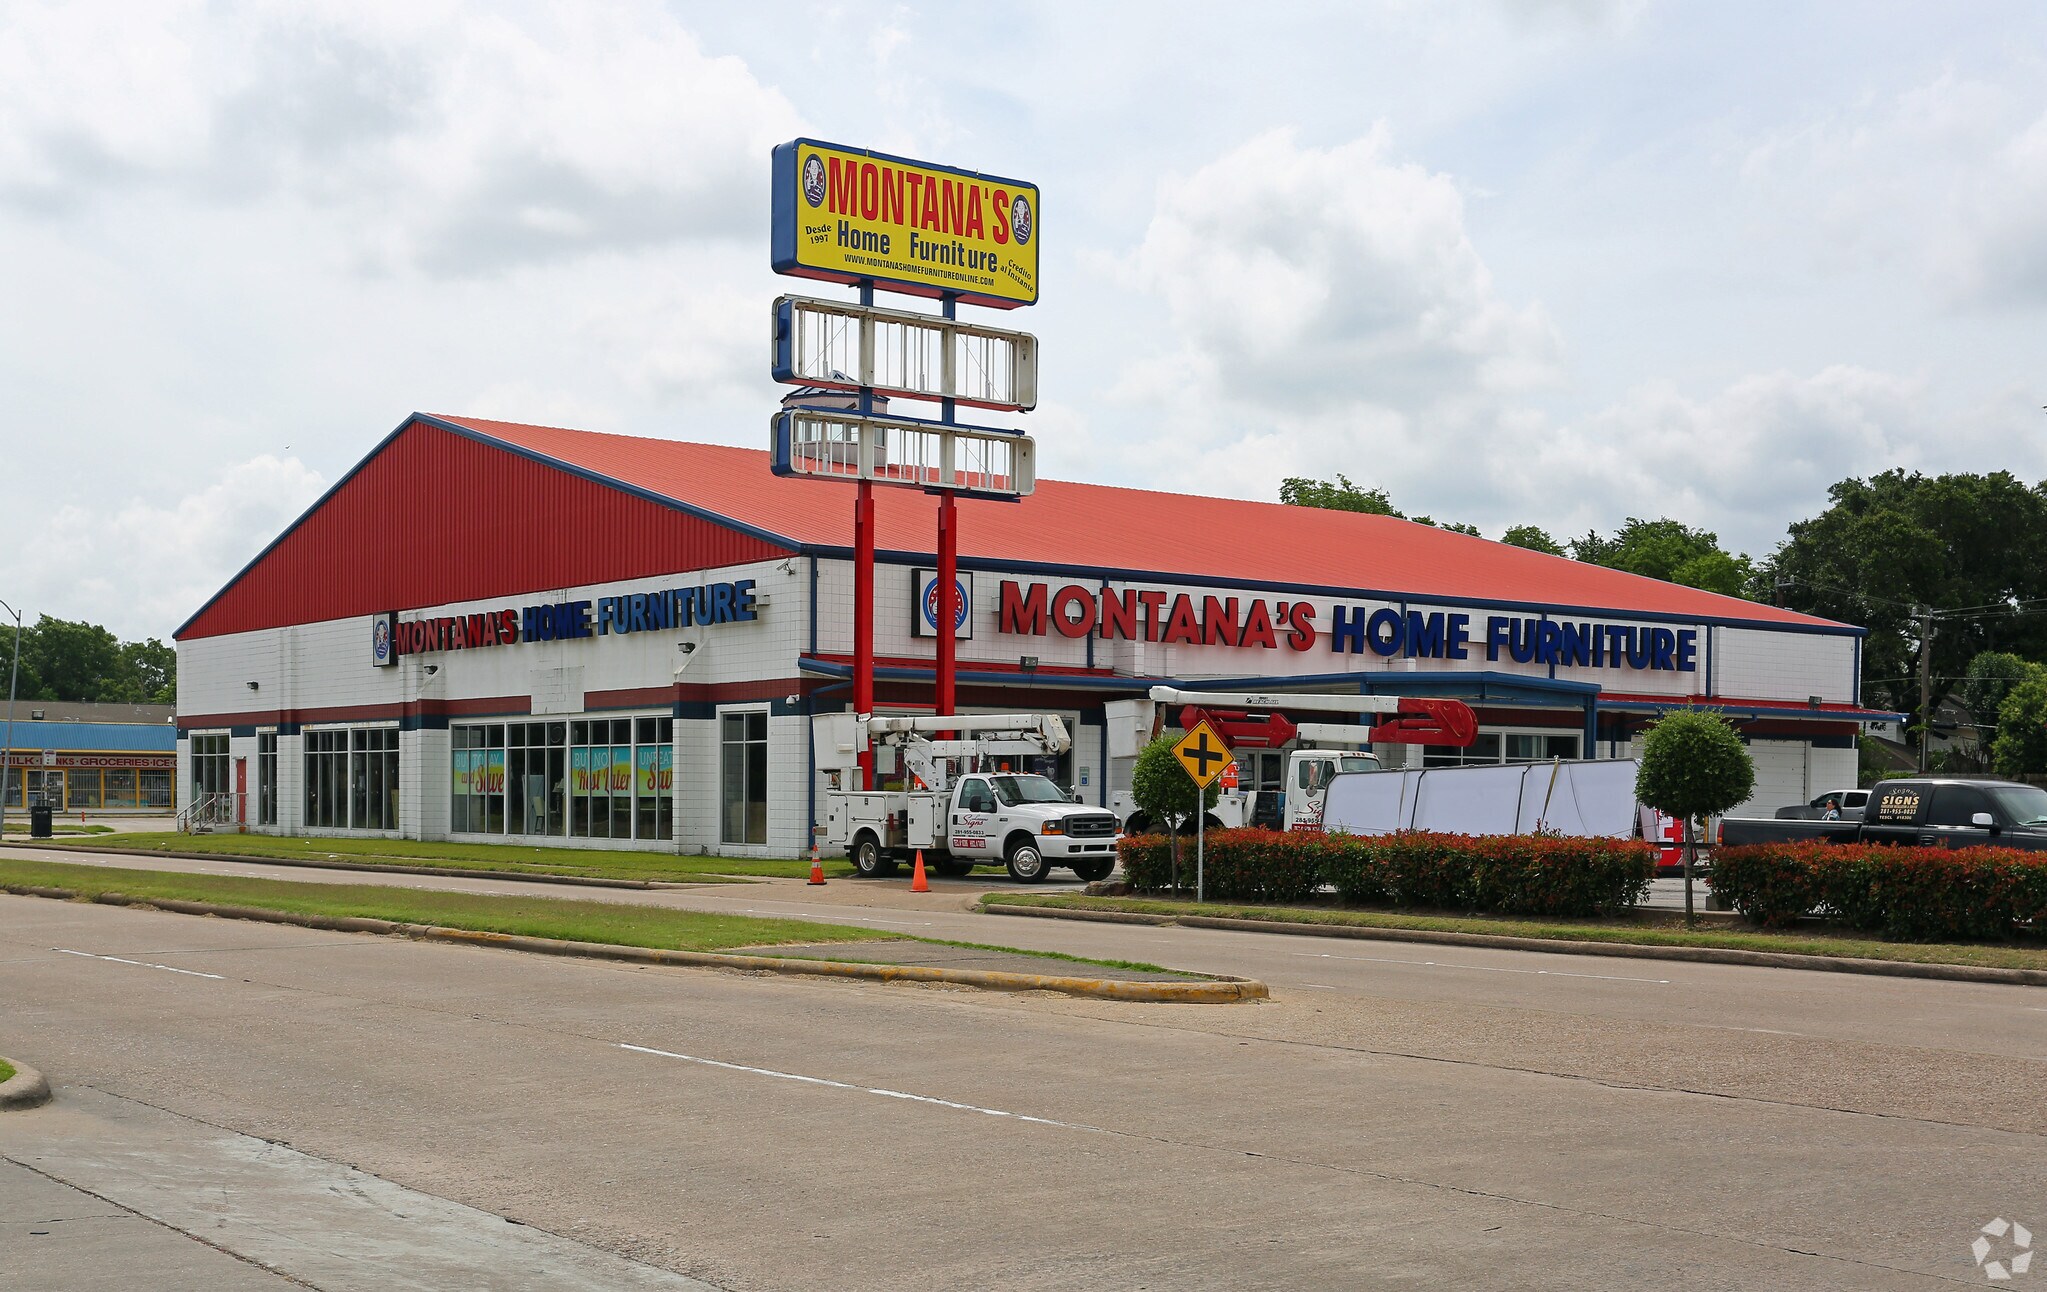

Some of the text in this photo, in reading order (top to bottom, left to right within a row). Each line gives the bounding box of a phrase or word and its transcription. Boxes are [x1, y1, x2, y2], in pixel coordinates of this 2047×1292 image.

[828, 156, 1009, 245] MONTANA'S
[805, 223, 832, 235] Desde
[810, 234, 829, 245] 1997
[837, 219, 998, 273] Home Furniture
[844, 253, 995, 286] WWW.MONTANASHOMEFURNITUREONLINE.COM
[1007, 268, 1034, 293] Instante
[1008, 259, 1032, 280] Credito
[395, 578, 757, 656] MONTANA'S HOME FURNITURE
[1000, 579, 1697, 673] MONTANA'S HOME FURNITURE
[80, 757, 150, 767] GROCERIES
[152, 758, 170, 767] ICE
[1881, 795, 1920, 805] SIGNS
